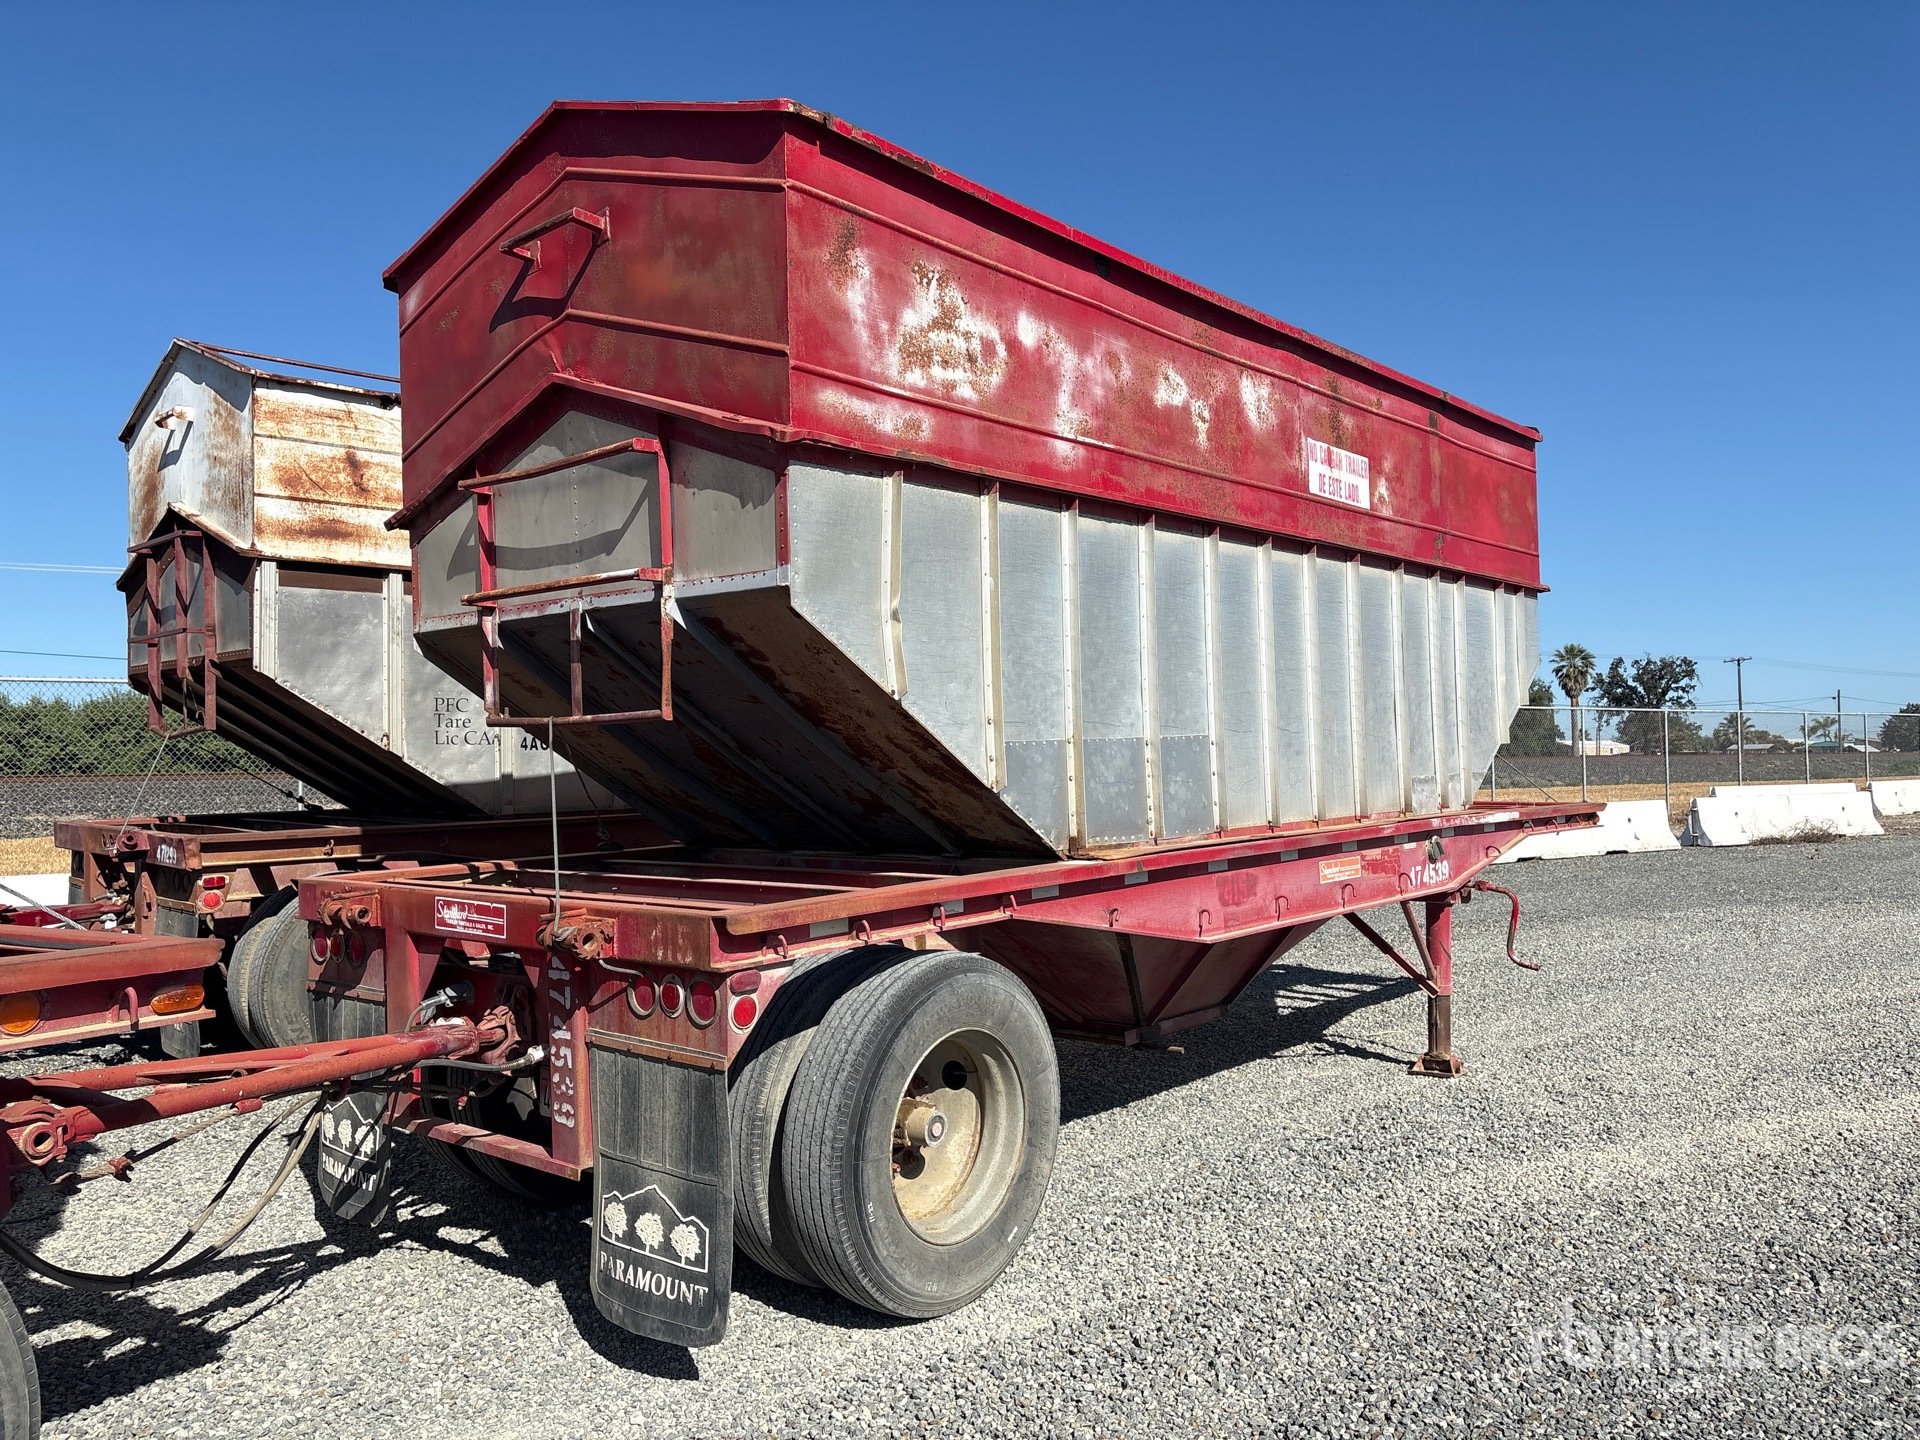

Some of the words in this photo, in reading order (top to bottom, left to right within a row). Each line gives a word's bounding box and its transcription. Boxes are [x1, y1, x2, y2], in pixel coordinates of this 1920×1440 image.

[1309, 441, 1317, 463] NO
[1319, 472, 1326, 494] DE
[1329, 475, 1342, 499] ESTE
[434, 697, 469, 713] PFC
[434, 713, 471, 728] Tare
[434, 730, 459, 746] Lic
[322, 1152, 377, 1192] PARAMOUNT
[599, 1250, 709, 1308] PARAMOUNT
